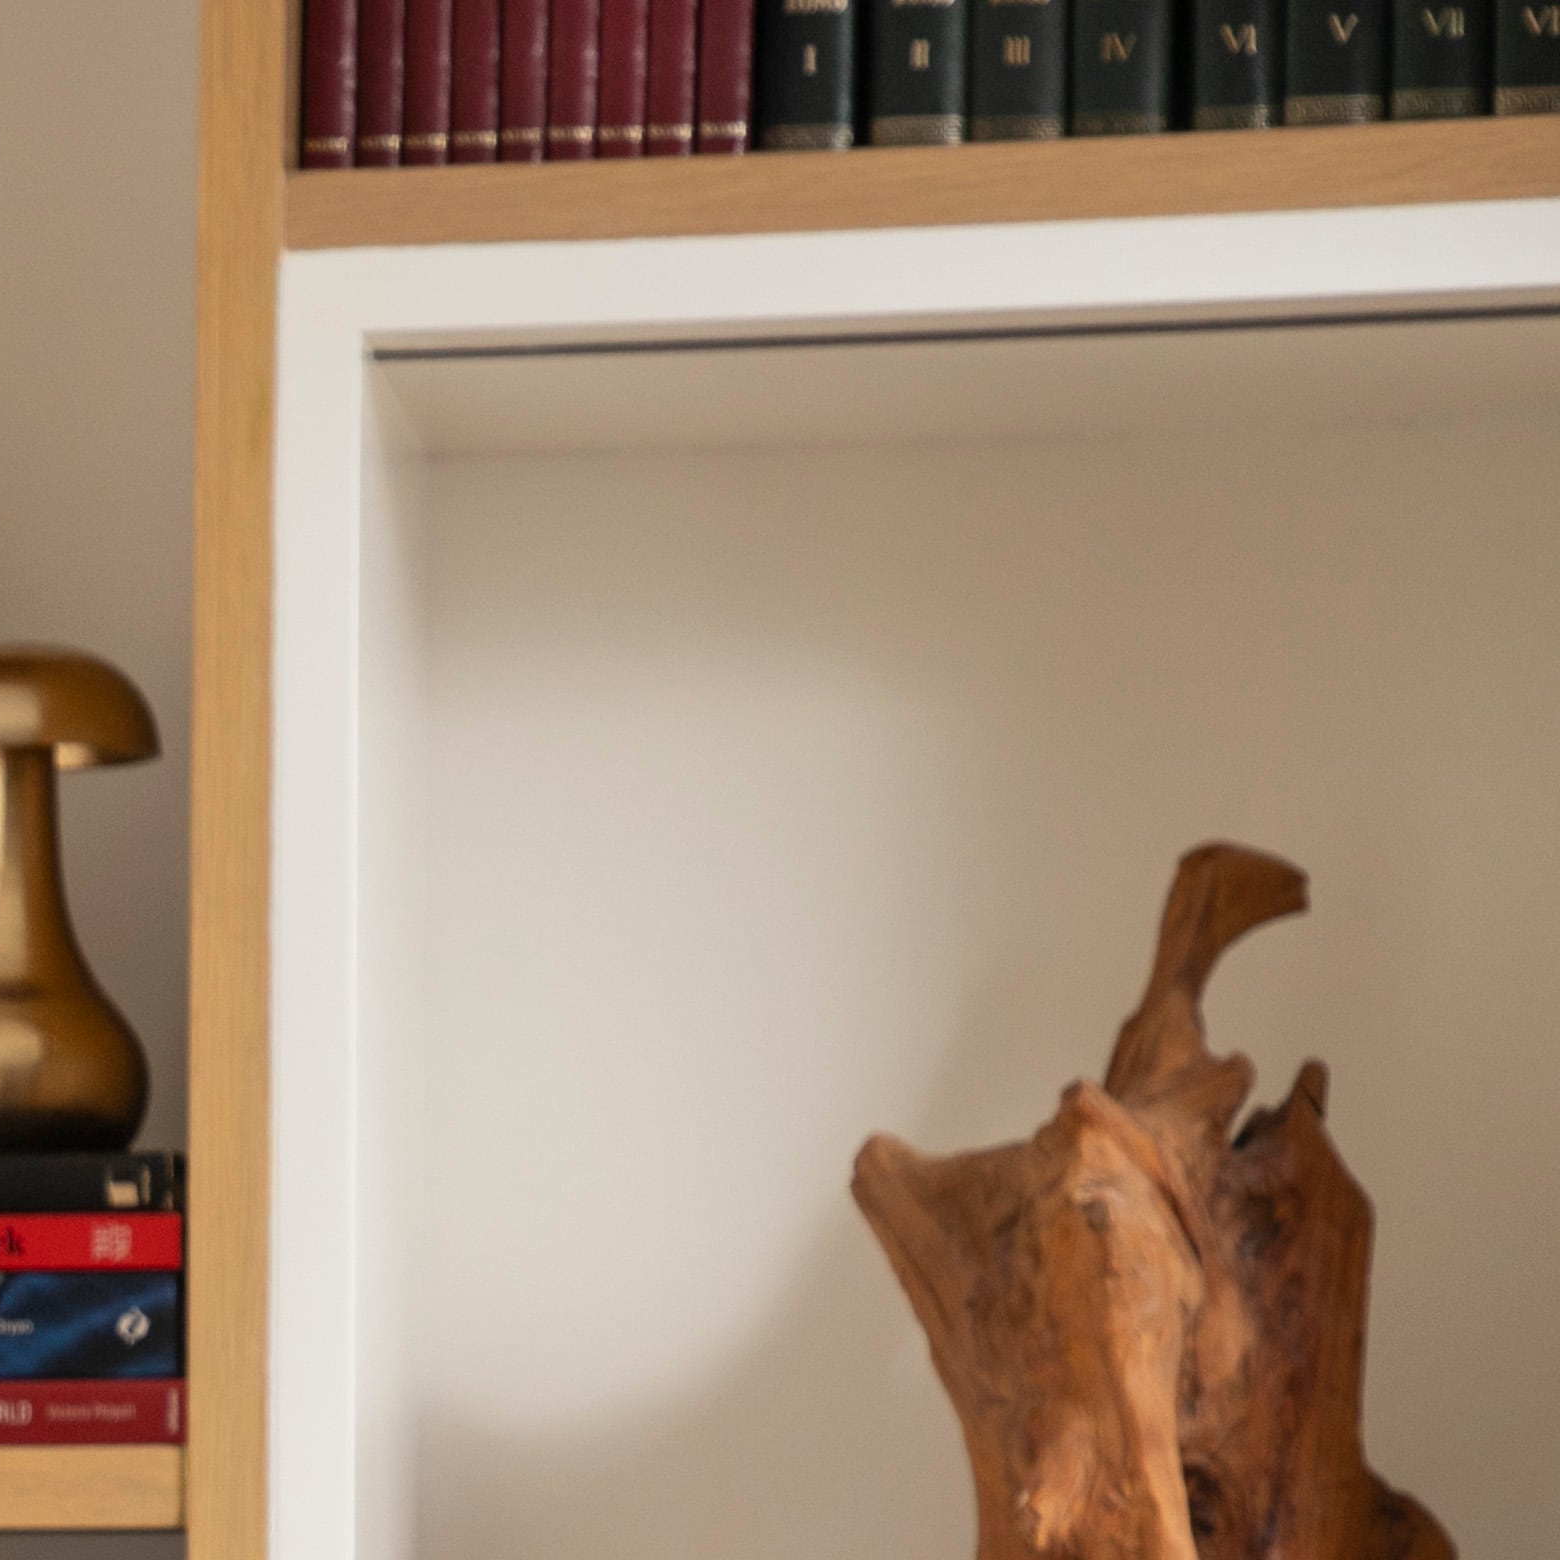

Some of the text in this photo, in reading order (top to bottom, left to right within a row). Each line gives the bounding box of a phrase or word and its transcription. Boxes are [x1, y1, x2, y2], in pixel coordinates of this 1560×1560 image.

[1219, 23, 1257, 55] VI
[1328, 13, 1359, 44] V
[803, 44, 817, 76] I
[909, 39, 930, 71] II
[1002, 35, 1031, 66] III
[1100, 32, 1136, 63] IV
